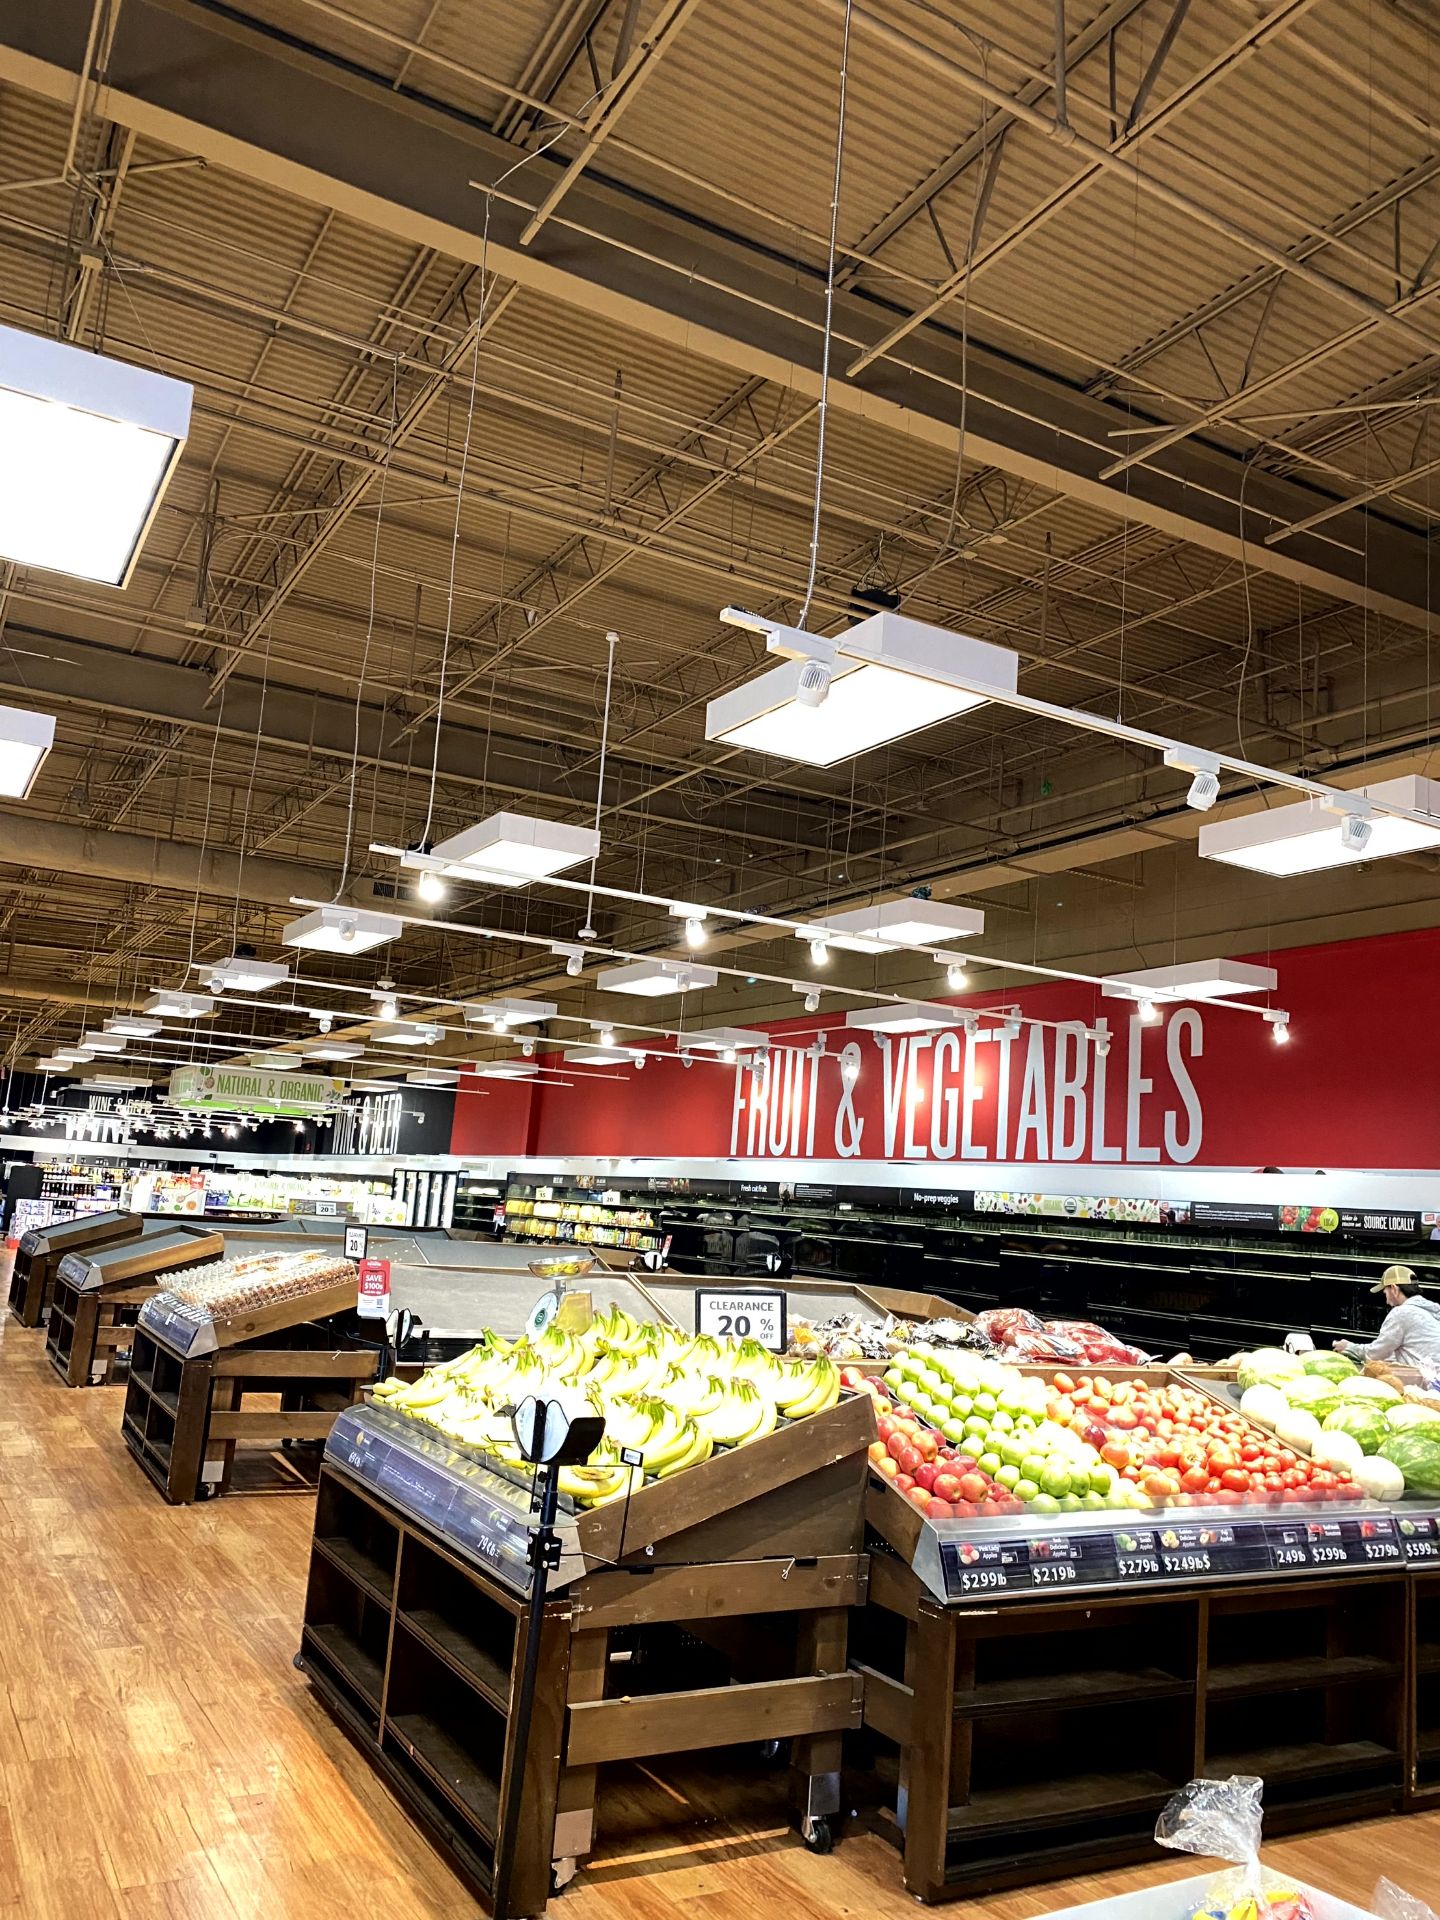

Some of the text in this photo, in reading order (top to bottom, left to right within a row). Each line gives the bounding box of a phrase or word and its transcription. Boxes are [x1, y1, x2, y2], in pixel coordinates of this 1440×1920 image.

[216, 1074, 325, 1102] NATURAL & ORGANIC
[730, 1008, 1205, 1165] FRUIT & VEGETABLES
[88, 1094, 114, 1112] WINE
[369, 1093, 403, 1155] BEER
[913, 1192, 959, 1205] No-prep veggies
[1363, 1215, 1388, 1230] SOURCE
[1389, 1217, 1416, 1232] LOCALLY
[350, 1239, 358, 1252] 20
[365, 1274, 383, 1282] SAVE
[364, 1282, 384, 1290] $100s
[709, 1300, 775, 1312] CLEARANCE
[717, 1315, 774, 1337] 20 %
[760, 1333, 774, 1341] OFF
